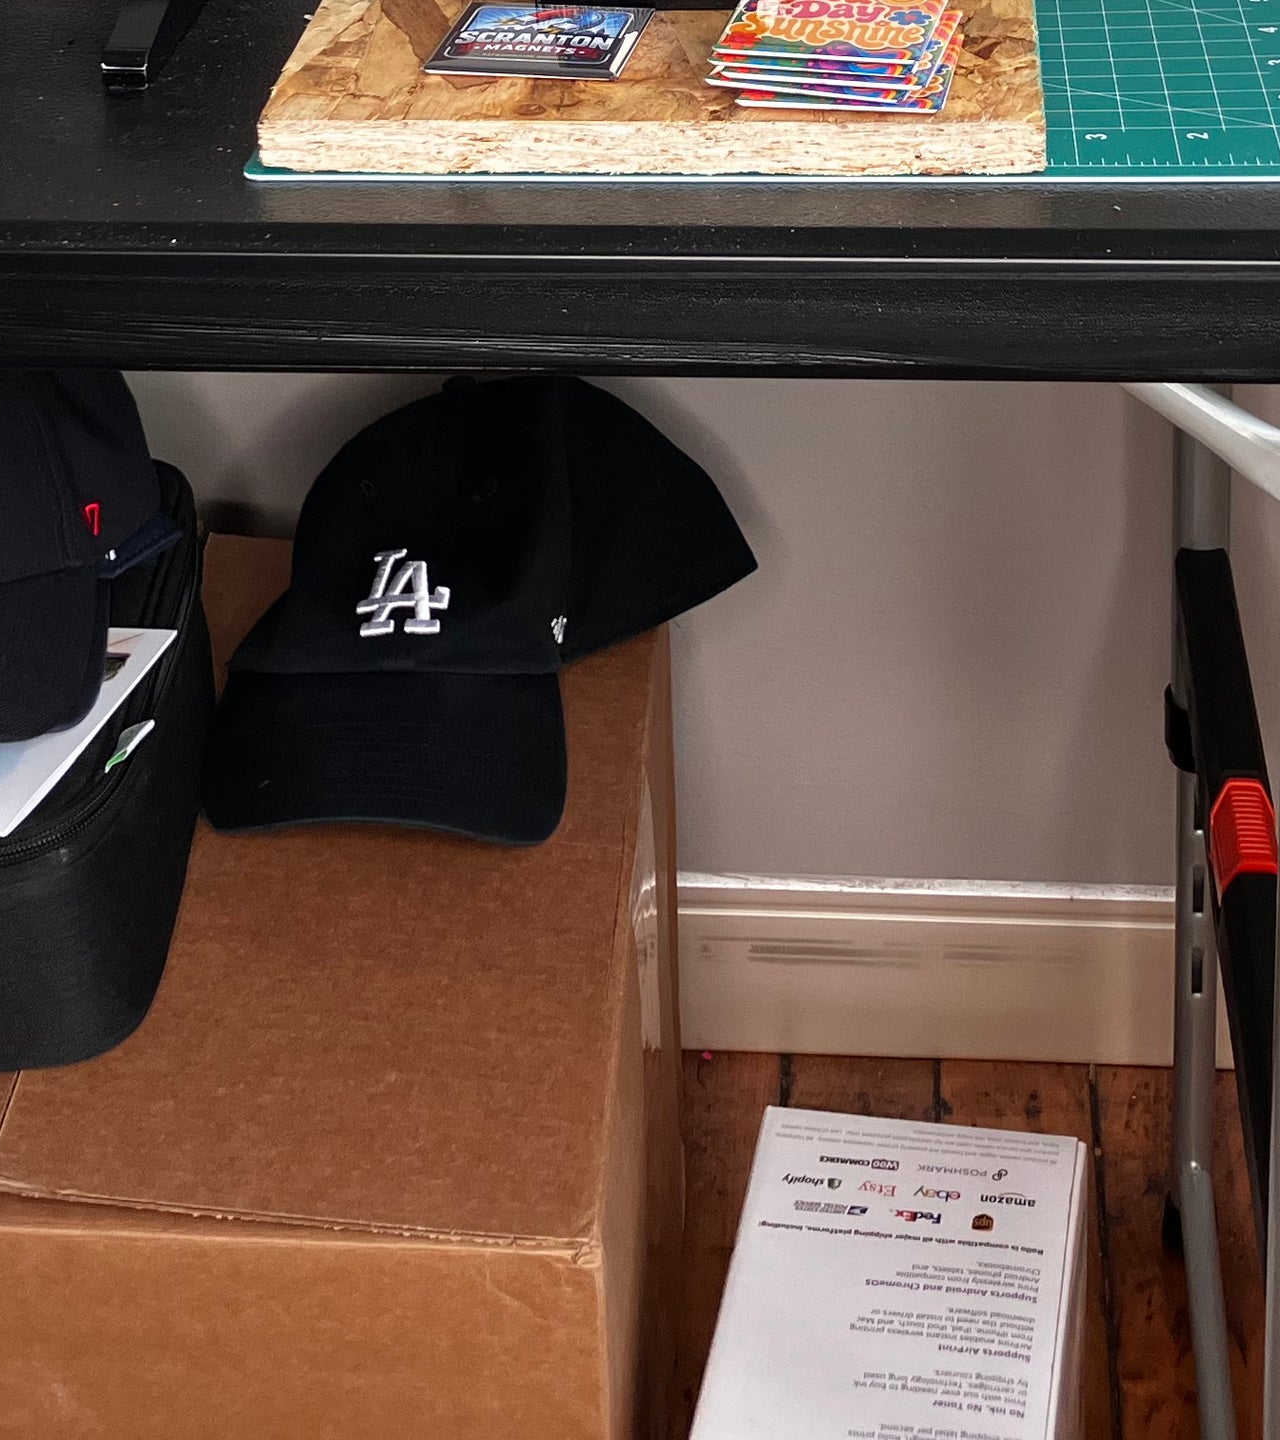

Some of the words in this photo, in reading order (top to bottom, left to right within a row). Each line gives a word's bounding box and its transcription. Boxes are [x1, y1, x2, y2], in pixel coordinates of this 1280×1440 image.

[791, 0, 886, 23] Day
[729, 12, 928, 50] Sunshine
[1258, 26, 1278, 34] 4
[455, 30, 616, 50] SCRANTON
[483, 43, 576, 54] MAGNETS
[1085, 133, 1107, 141] 3
[1186, 132, 1209, 140] 2
[355, 548, 451, 638] LA
[917, 1164, 987, 1178] POSHMARK
[781, 1173, 825, 1187] shopify
[858, 1180, 897, 1198] Etsy
[913, 1186, 961, 1202] ebay
[980, 1194, 1036, 1208] amazon
[894, 1209, 942, 1224] FedEx
[973, 1217, 993, 1228] ups
[854, 1229, 893, 1239] shipping
[935, 1237, 955, 1245] with
[958, 1239, 1009, 1250] compatible
[1021, 1246, 1044, 1255] Rollo
[865, 1279, 920, 1290] ChromeOS
[922, 1284, 943, 1294] and
[945, 1286, 988, 1297] Android
[990, 1290, 1038, 1304] Supports
[938, 1343, 980, 1355] AirPrint
[982, 1348, 1031, 1363] Supports
[932, 1400, 963, 1410] Toner
[967, 1403, 982, 1412] No
[1009, 1408, 1025, 1418] No
